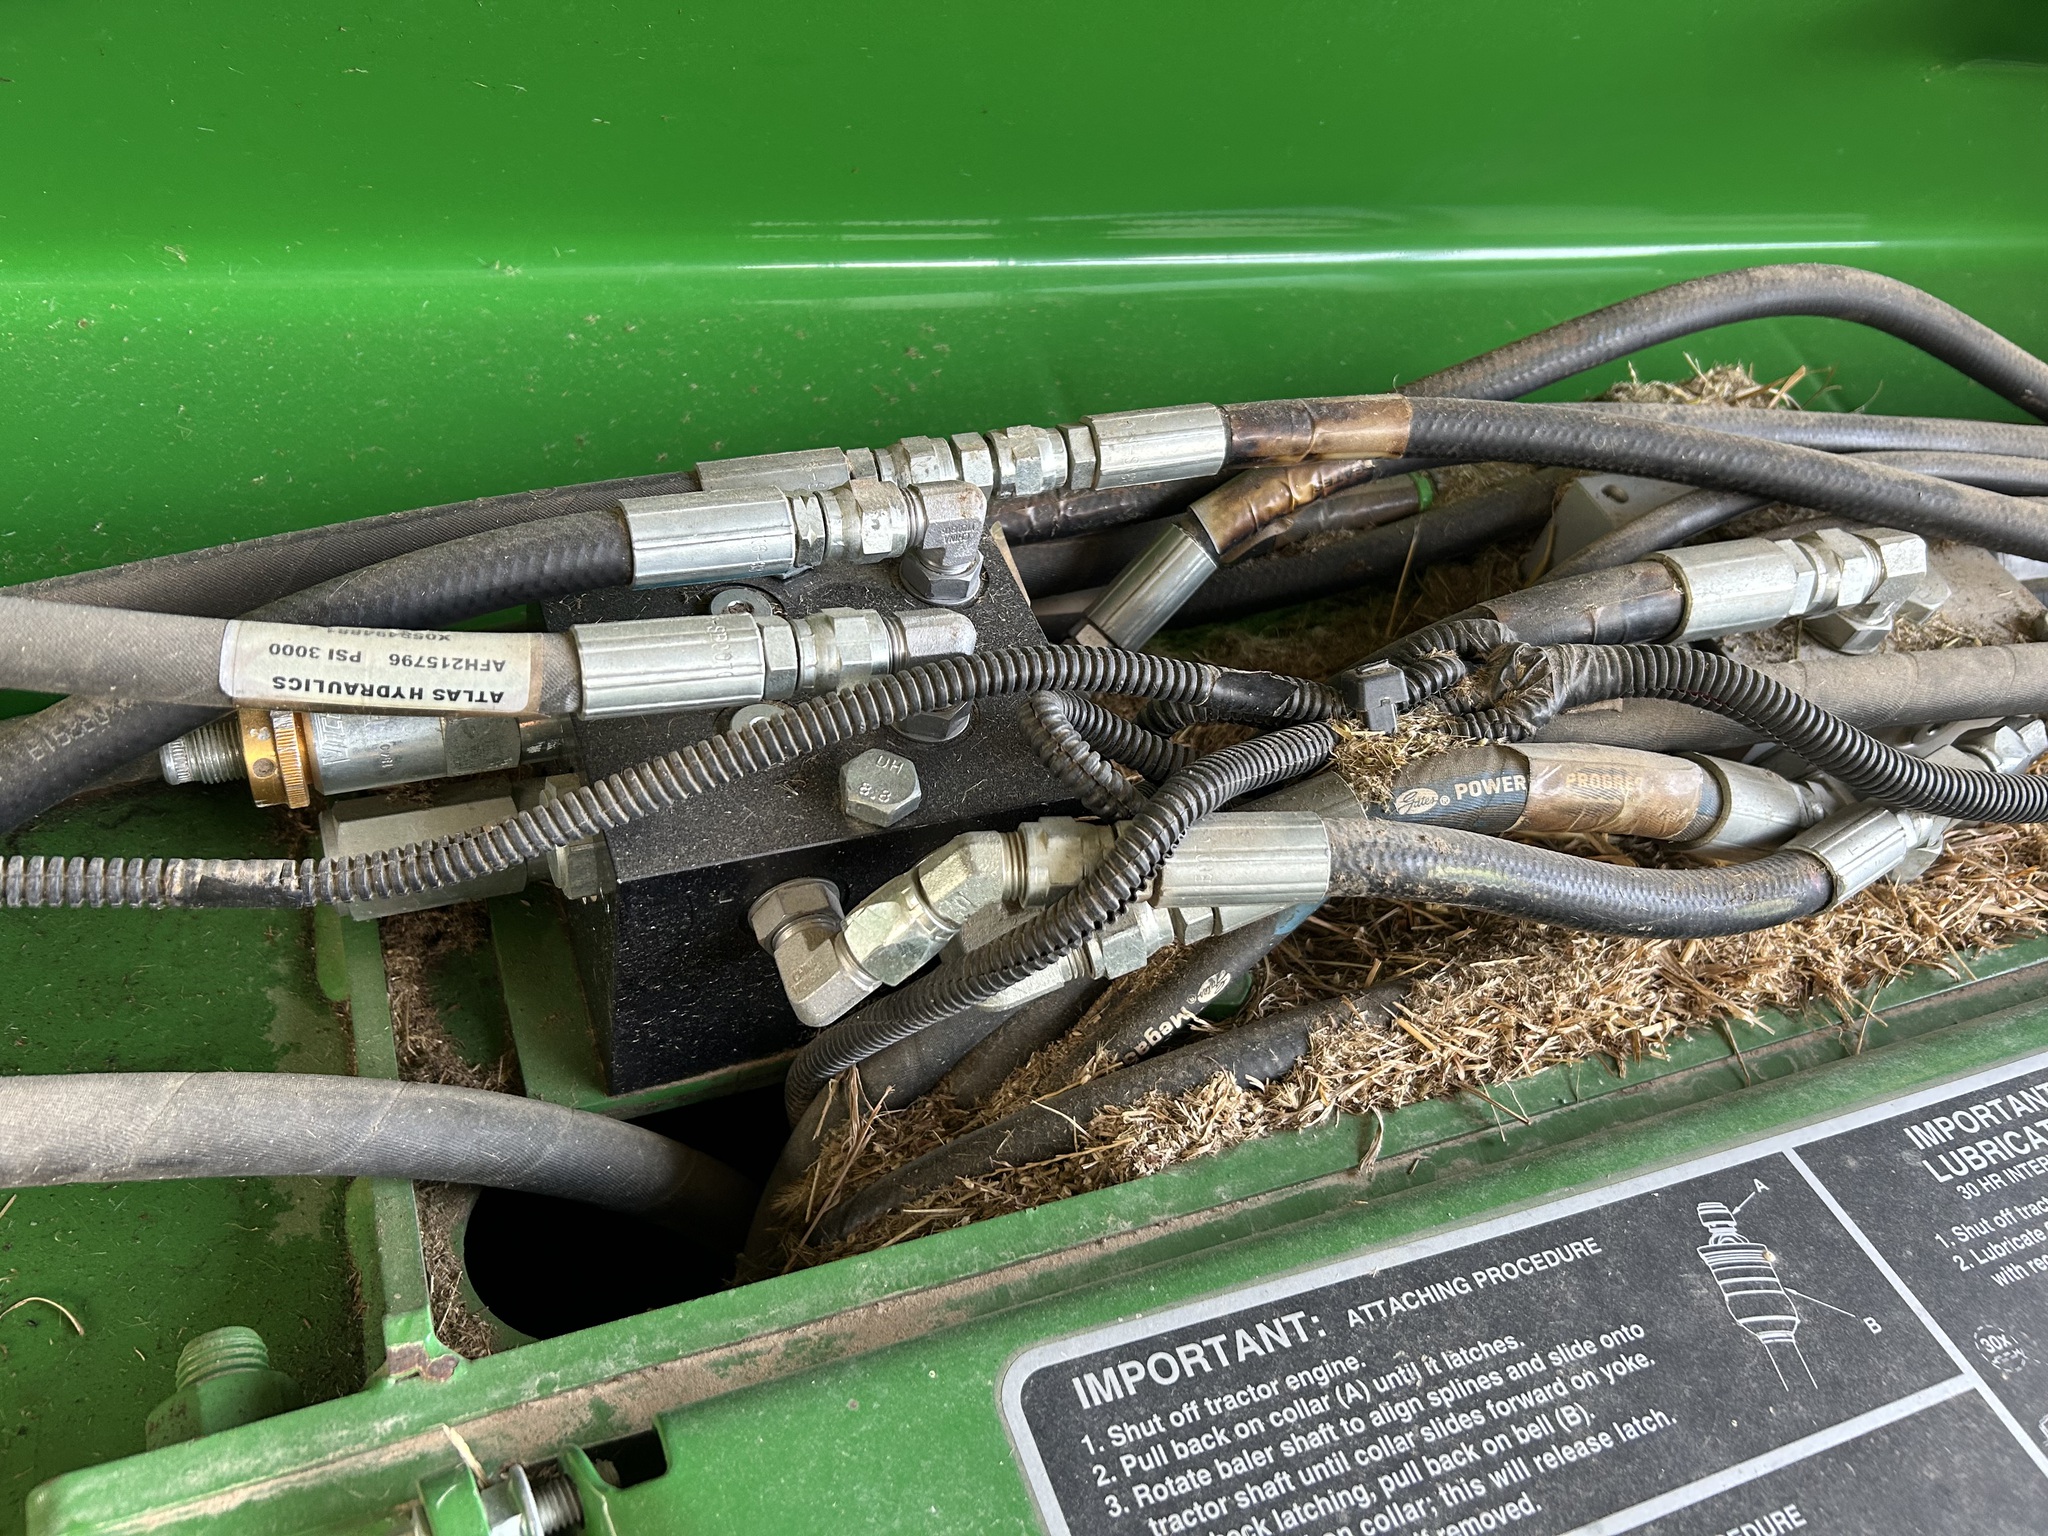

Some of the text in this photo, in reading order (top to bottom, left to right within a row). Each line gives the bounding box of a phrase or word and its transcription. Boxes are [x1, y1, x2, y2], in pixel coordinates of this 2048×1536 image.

[268, 643, 506, 673] AFH215796 PSI 3000
[272, 675, 505, 704] ATLAS HYDRAULICS
[875, 755, 904, 775] UH
[859, 782, 892, 803] 8.8
[1454, 774, 1528, 801] POWER
[1753, 1178, 1770, 1193] A
[1956, 1181, 1981, 1201] 30
[1977, 1172, 2008, 1193] HR
[1934, 1232, 1956, 1250] 1.
[1951, 1216, 1996, 1243] Shut
[1993, 1207, 2018, 1229] off
[1952, 1226, 2048, 1272] 2. Lubricate
[1990, 1259, 2030, 1287] with
[1072, 1236, 1602, 1409] IMPORTANT: ATTACHING PROCEDURE
[1863, 1316, 1882, 1335] B
[1081, 1354, 1366, 1455] 1. Shut off tractor engine.
[1091, 1334, 1526, 1488] 2. Pull back on collar (A) until it latches.
[1104, 1322, 1646, 1518] 3. Rotate baler shaft to align splines and slide onto
[1148, 1496, 1229, 1536] tractor
[1233, 1470, 1296, 1509] shaft
[1297, 1450, 1352, 1488] until
[1354, 1430, 1417, 1467] collar
[1420, 1407, 1487, 1444] slides
[1486, 1378, 1570, 1419] forward
[1571, 1369, 1601, 1392] on
[1599, 1350, 1657, 1386] yoke.
[1271, 1483, 1377, 1532] latching,
[1377, 1459, 1424, 1500] pull
[1422, 1441, 1482, 1478] back
[1482, 1431, 1513, 1457] on
[1511, 1413, 1556, 1446] bell
[1555, 1402, 1596, 1433] (B).
[1360, 1407, 1678, 1536] collar; this will release latch.
